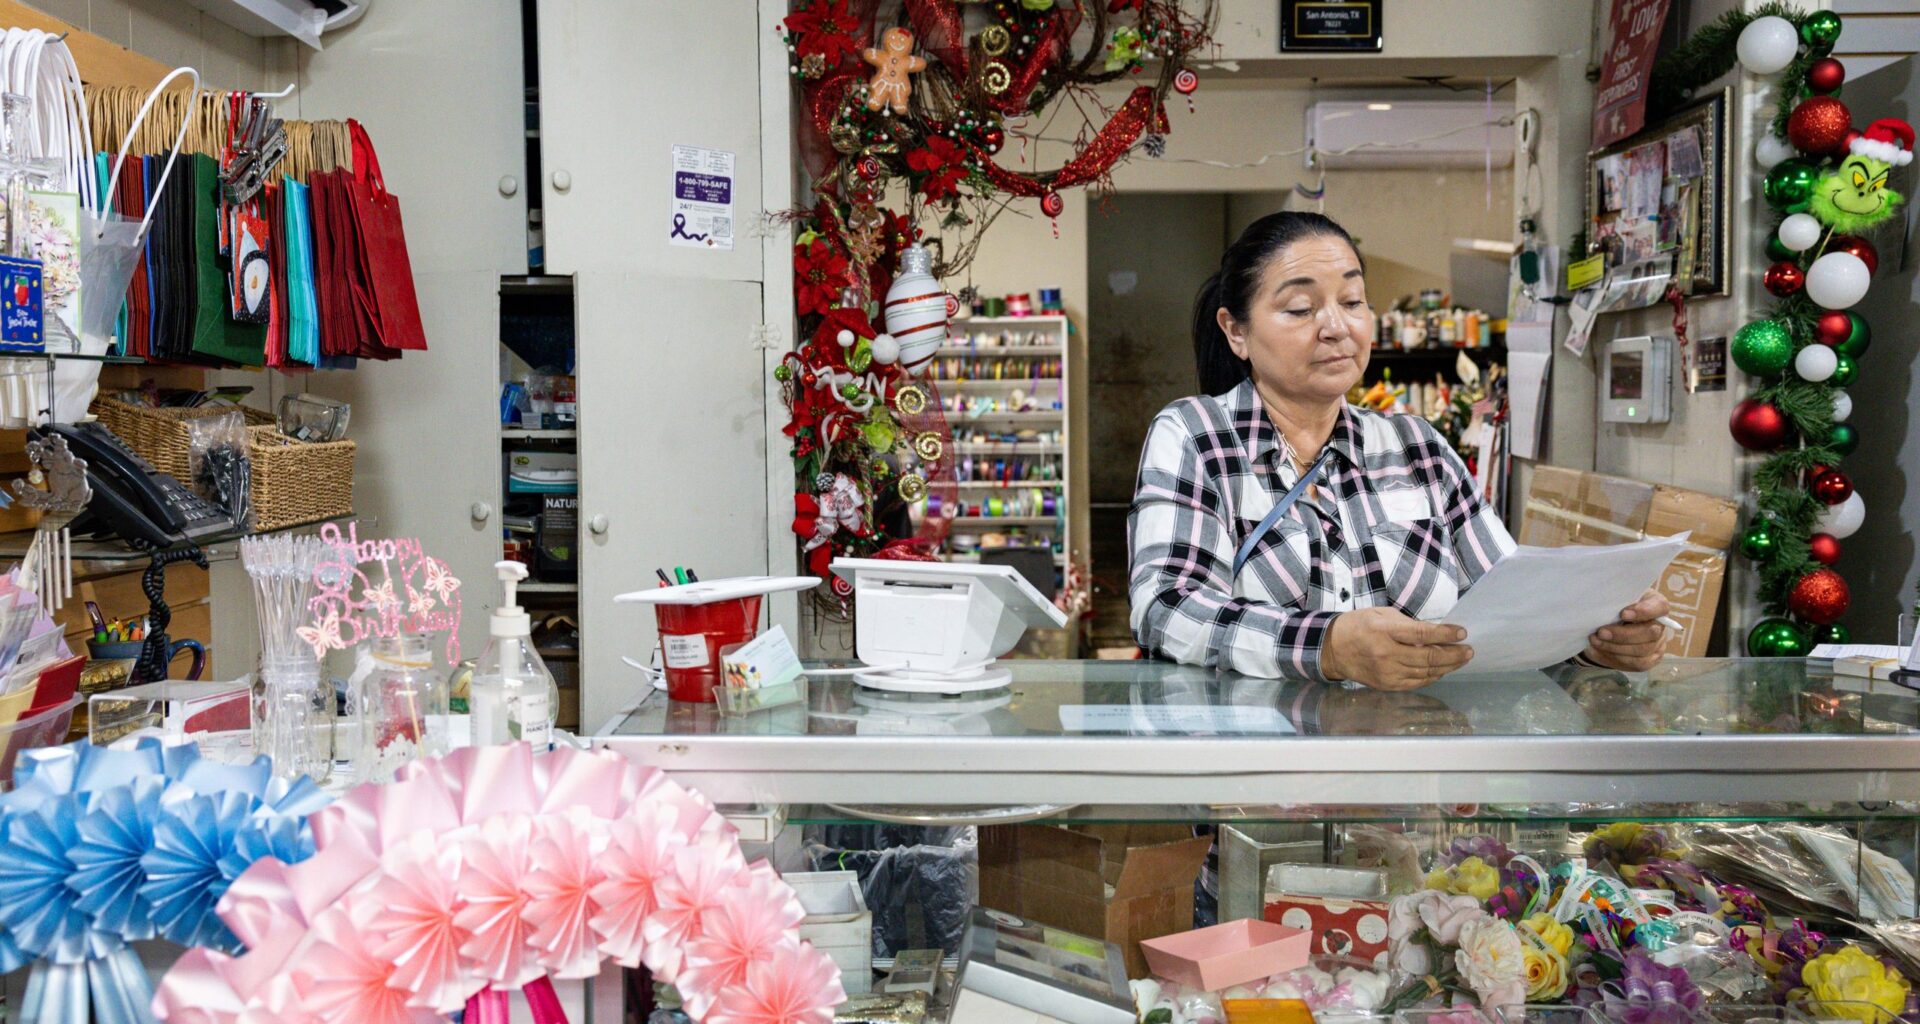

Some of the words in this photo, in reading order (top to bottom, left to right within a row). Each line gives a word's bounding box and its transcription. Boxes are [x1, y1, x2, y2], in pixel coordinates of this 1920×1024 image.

[1306, 11, 1319, 19] San
[1629, 1, 1660, 38] LOVE
[678, 177, 728, 189] 1-800-799-SAFE
